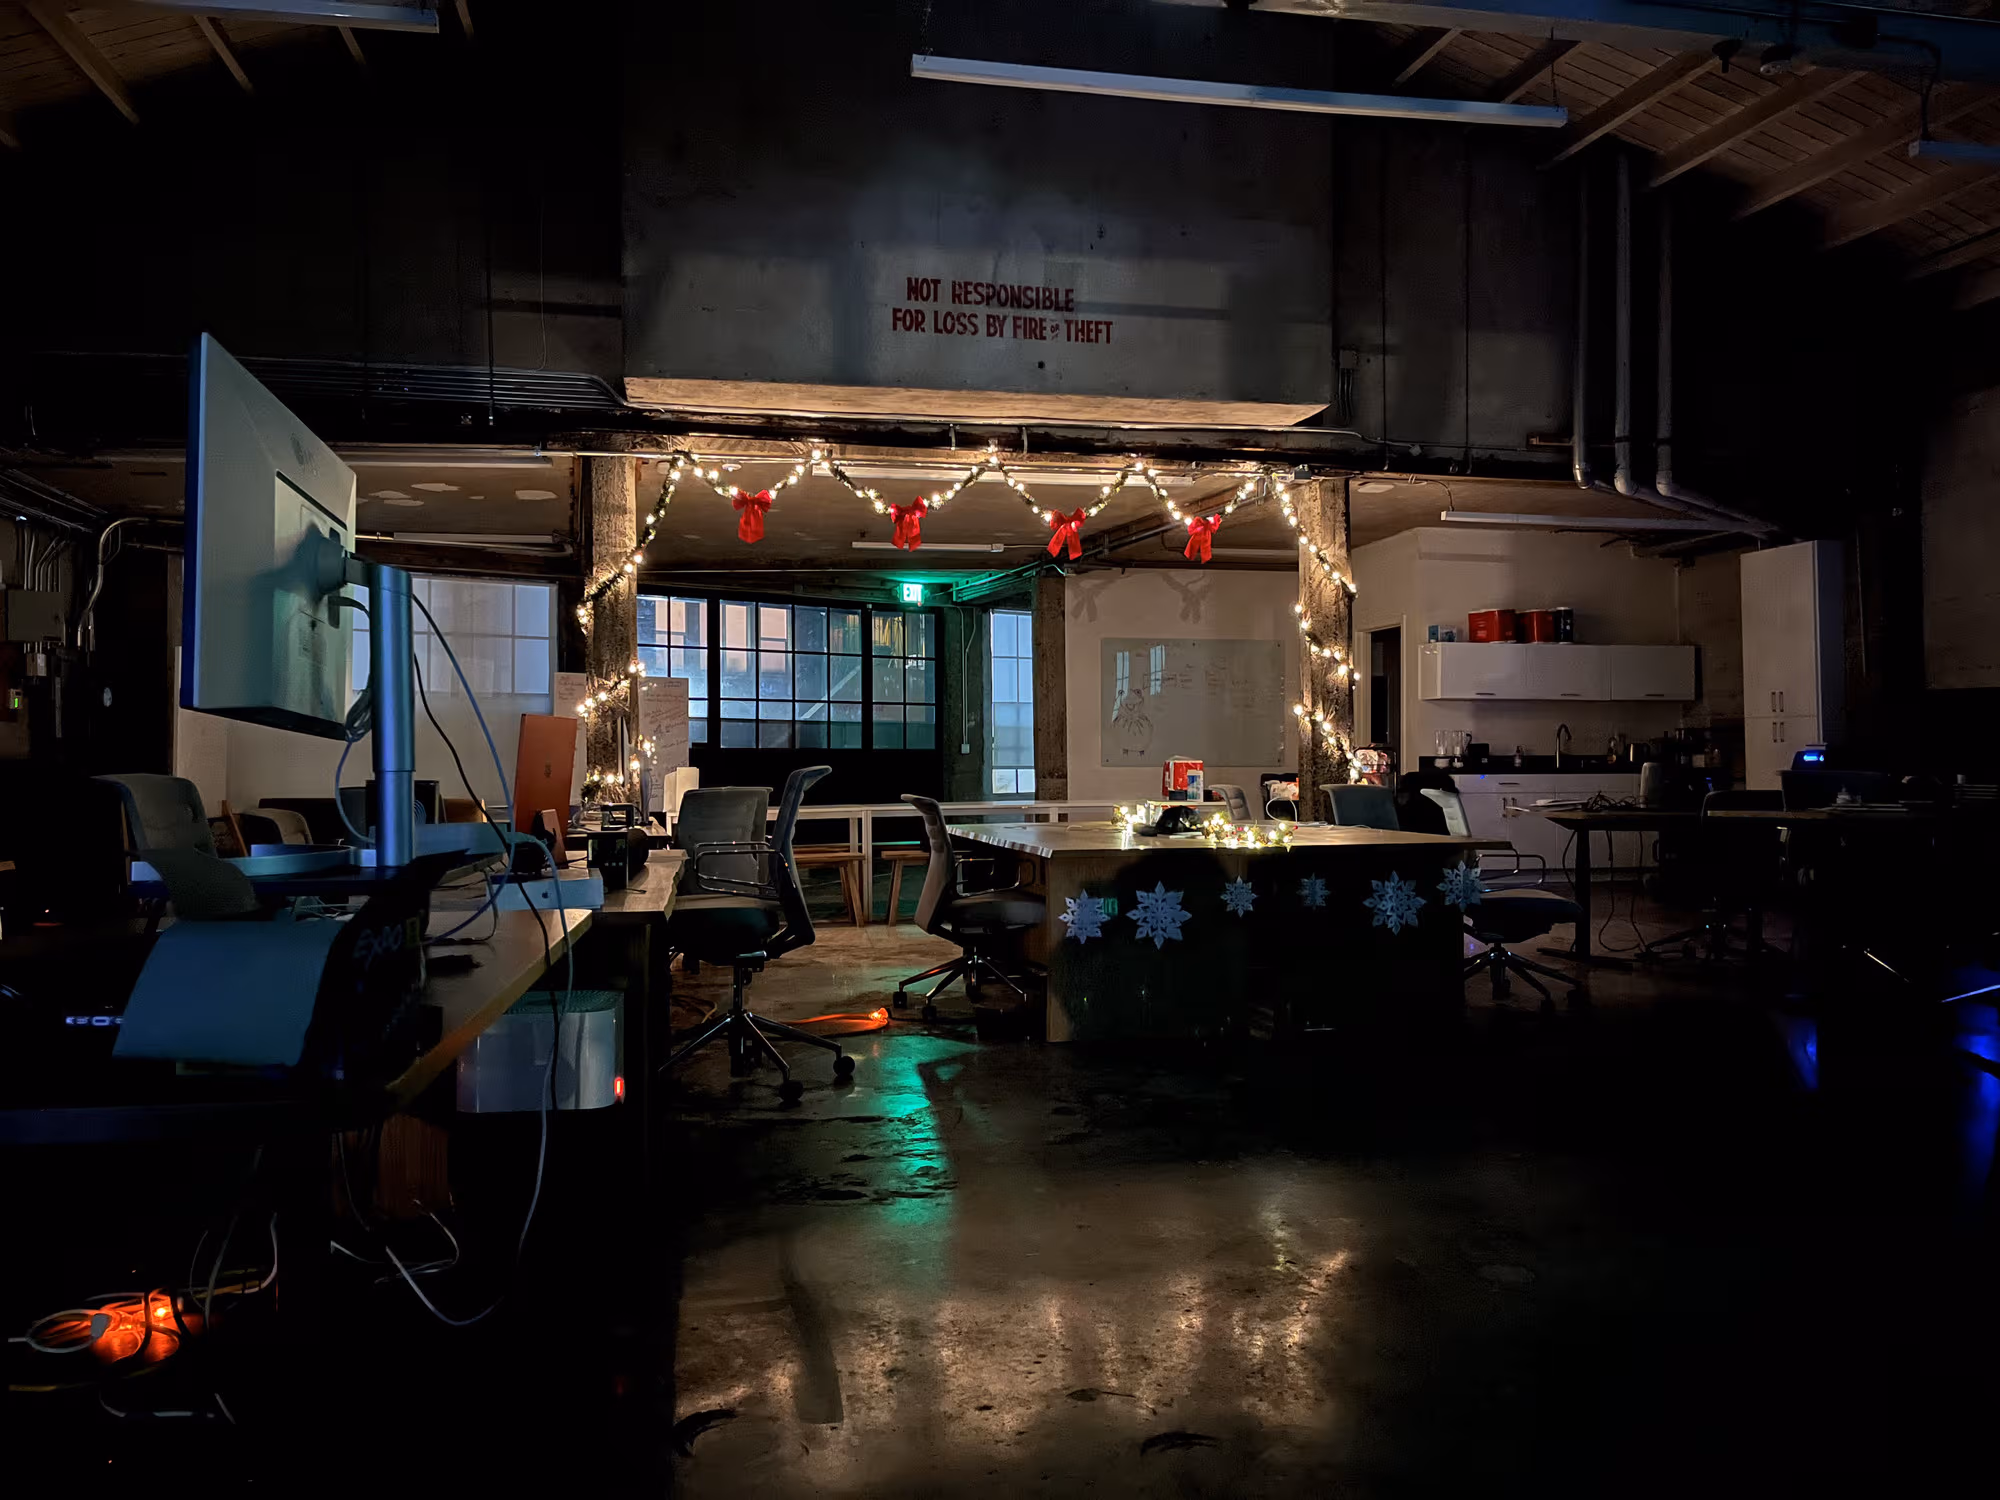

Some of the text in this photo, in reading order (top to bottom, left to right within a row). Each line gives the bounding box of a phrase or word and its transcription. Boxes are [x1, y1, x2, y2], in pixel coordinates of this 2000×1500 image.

[906, 277, 1074, 312] NOT RESPONSIBLE
[892, 308, 926, 333] FOR
[933, 310, 979, 336] LOSS
[986, 314, 1006, 338] BY
[1012, 316, 1047, 340] FIRE
[1064, 319, 1114, 344] THEFT
